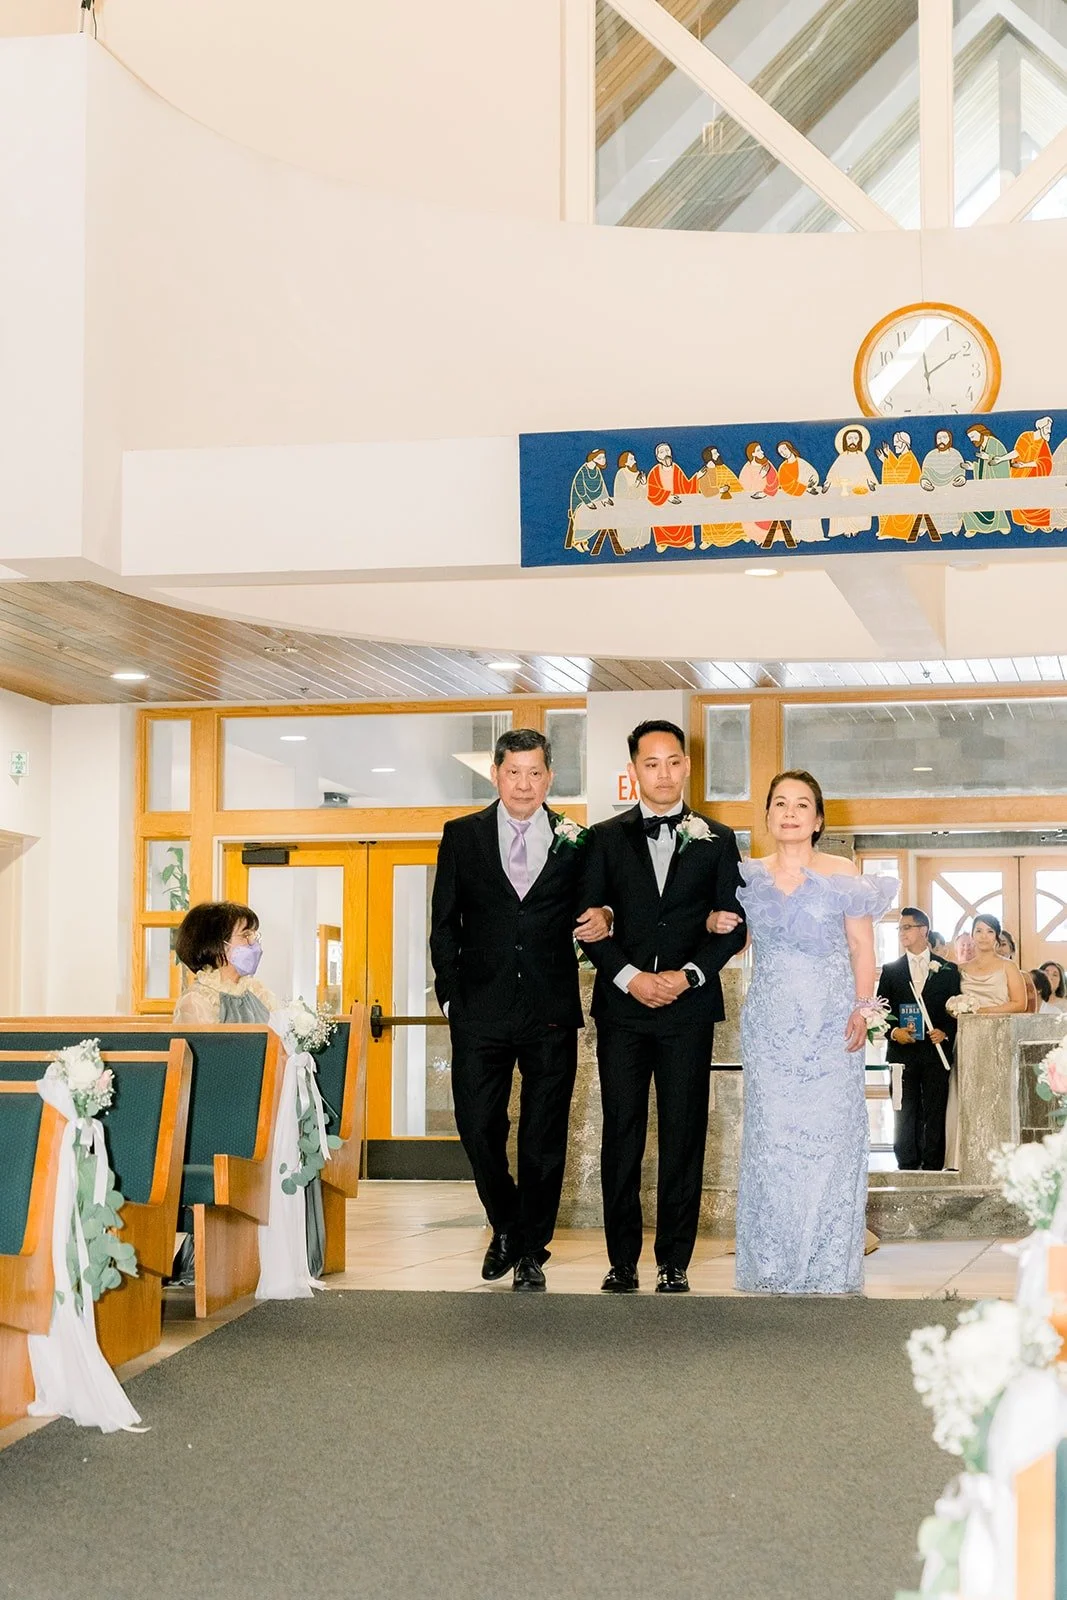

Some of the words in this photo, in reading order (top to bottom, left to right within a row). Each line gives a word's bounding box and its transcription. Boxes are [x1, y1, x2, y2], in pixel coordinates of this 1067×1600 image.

[896, 331, 907, 347] 11
[946, 326, 950, 341] 1
[962, 341, 971, 356] 2
[880, 351, 894, 366] 10
[972, 363, 981, 378] 3
[965, 386, 974, 401] 4
[883, 396, 893, 412] 8
[618, 775, 638, 800] EX
